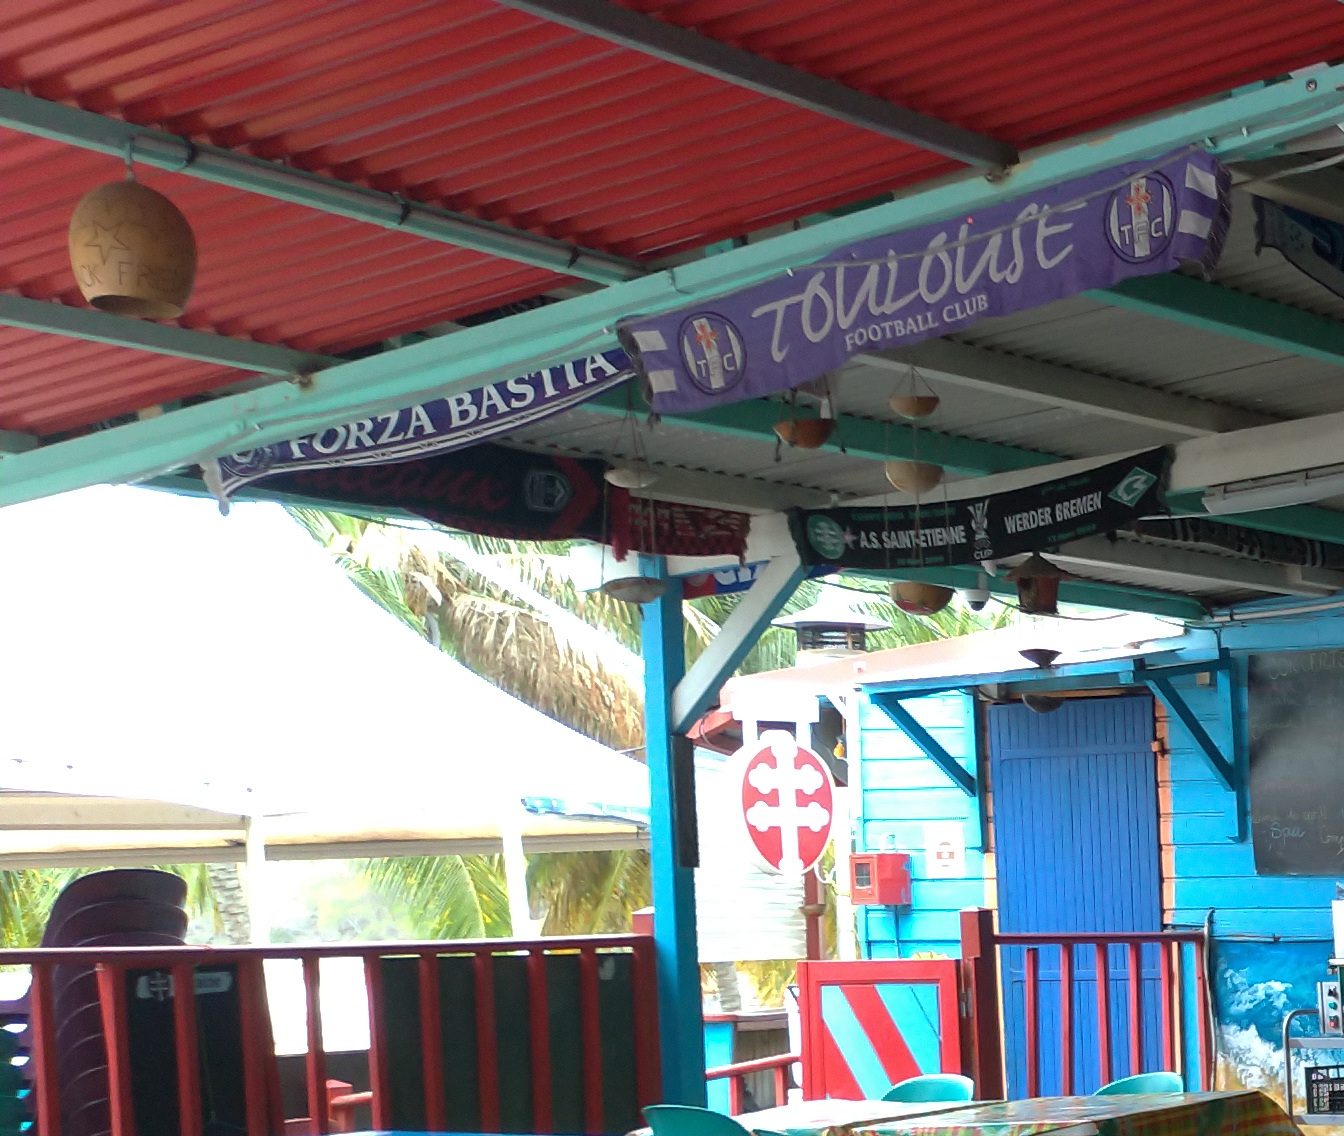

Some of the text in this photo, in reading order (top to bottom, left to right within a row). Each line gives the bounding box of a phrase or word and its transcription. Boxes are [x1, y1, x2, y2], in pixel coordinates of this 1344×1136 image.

[752, 200, 1089, 363] TOULOUSE
[844, 294, 989, 352] FOOTBALL CLUB
[288, 352, 620, 461] FORZA BASTIA
[881, 525, 968, 550] SAINT-ETIENNE
[1003, 506, 1054, 535] WERDER
[1054, 490, 1103, 523] BREMEN
